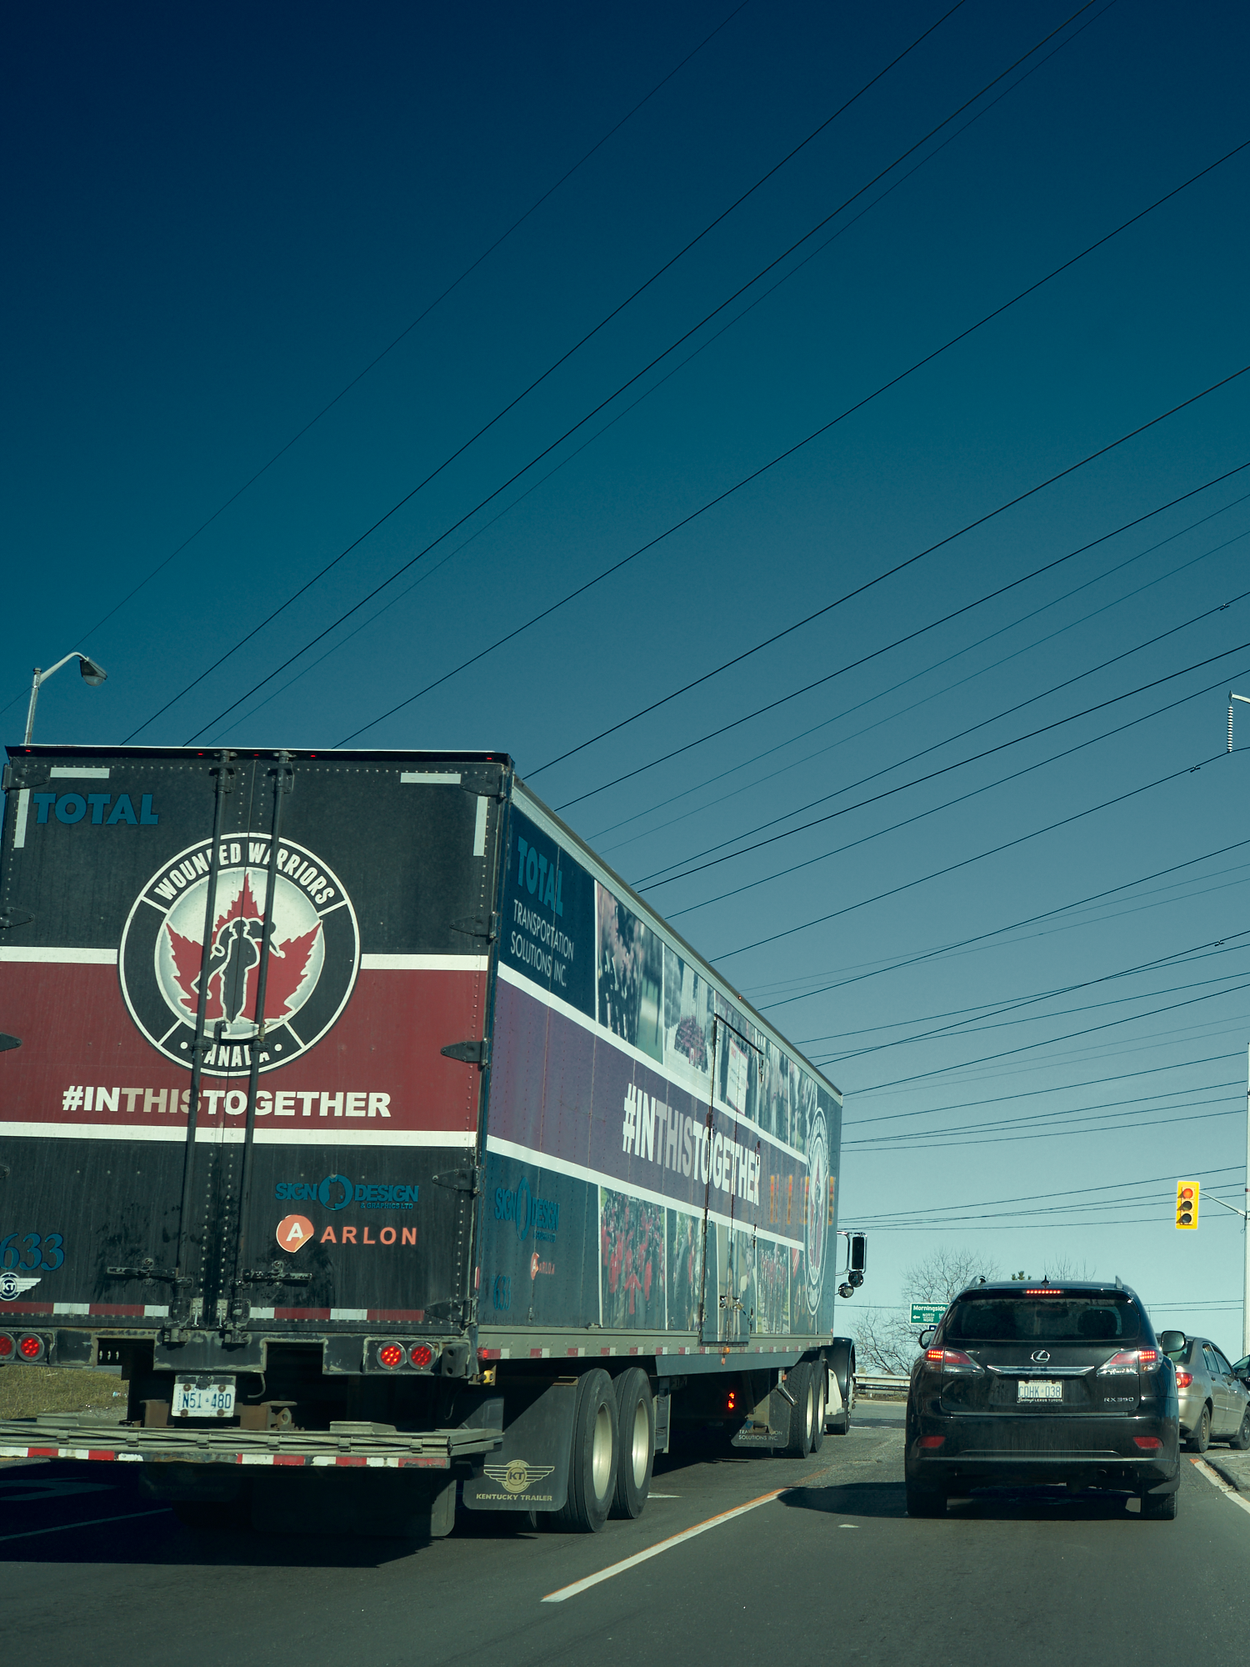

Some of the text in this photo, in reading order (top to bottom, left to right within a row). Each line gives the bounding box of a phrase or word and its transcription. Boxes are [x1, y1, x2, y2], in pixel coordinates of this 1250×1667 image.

[33, 793, 159, 825] TOTAL
[154, 843, 241, 901] WOUNED
[518, 836, 564, 917] TOTAL
[513, 899, 575, 962] TRANSPORTATION
[510, 931, 567, 987] SOLUTIONS INC.
[200, 1043, 270, 1067] ANAA
[62, 1085, 392, 1118] #INTHISTOGETHER
[622, 1083, 761, 1206] #INTHISTOGETHER
[275, 1182, 419, 1202] SIGN DESIGN
[494, 1188, 560, 1231] SIGN DESIGN
[320, 1226, 417, 1245] ARLON
[0, 1233, 64, 1271] 633
[3, 1282, 16, 1291] KT
[913, 1305, 947, 1313] Morningside
[182, 1392, 201, 1409] N51
[1045, 1386, 1061, 1397] 038
[509, 1472, 524, 1480] KT
[476, 1493, 553, 1502] KENTUCKY TRAILER
